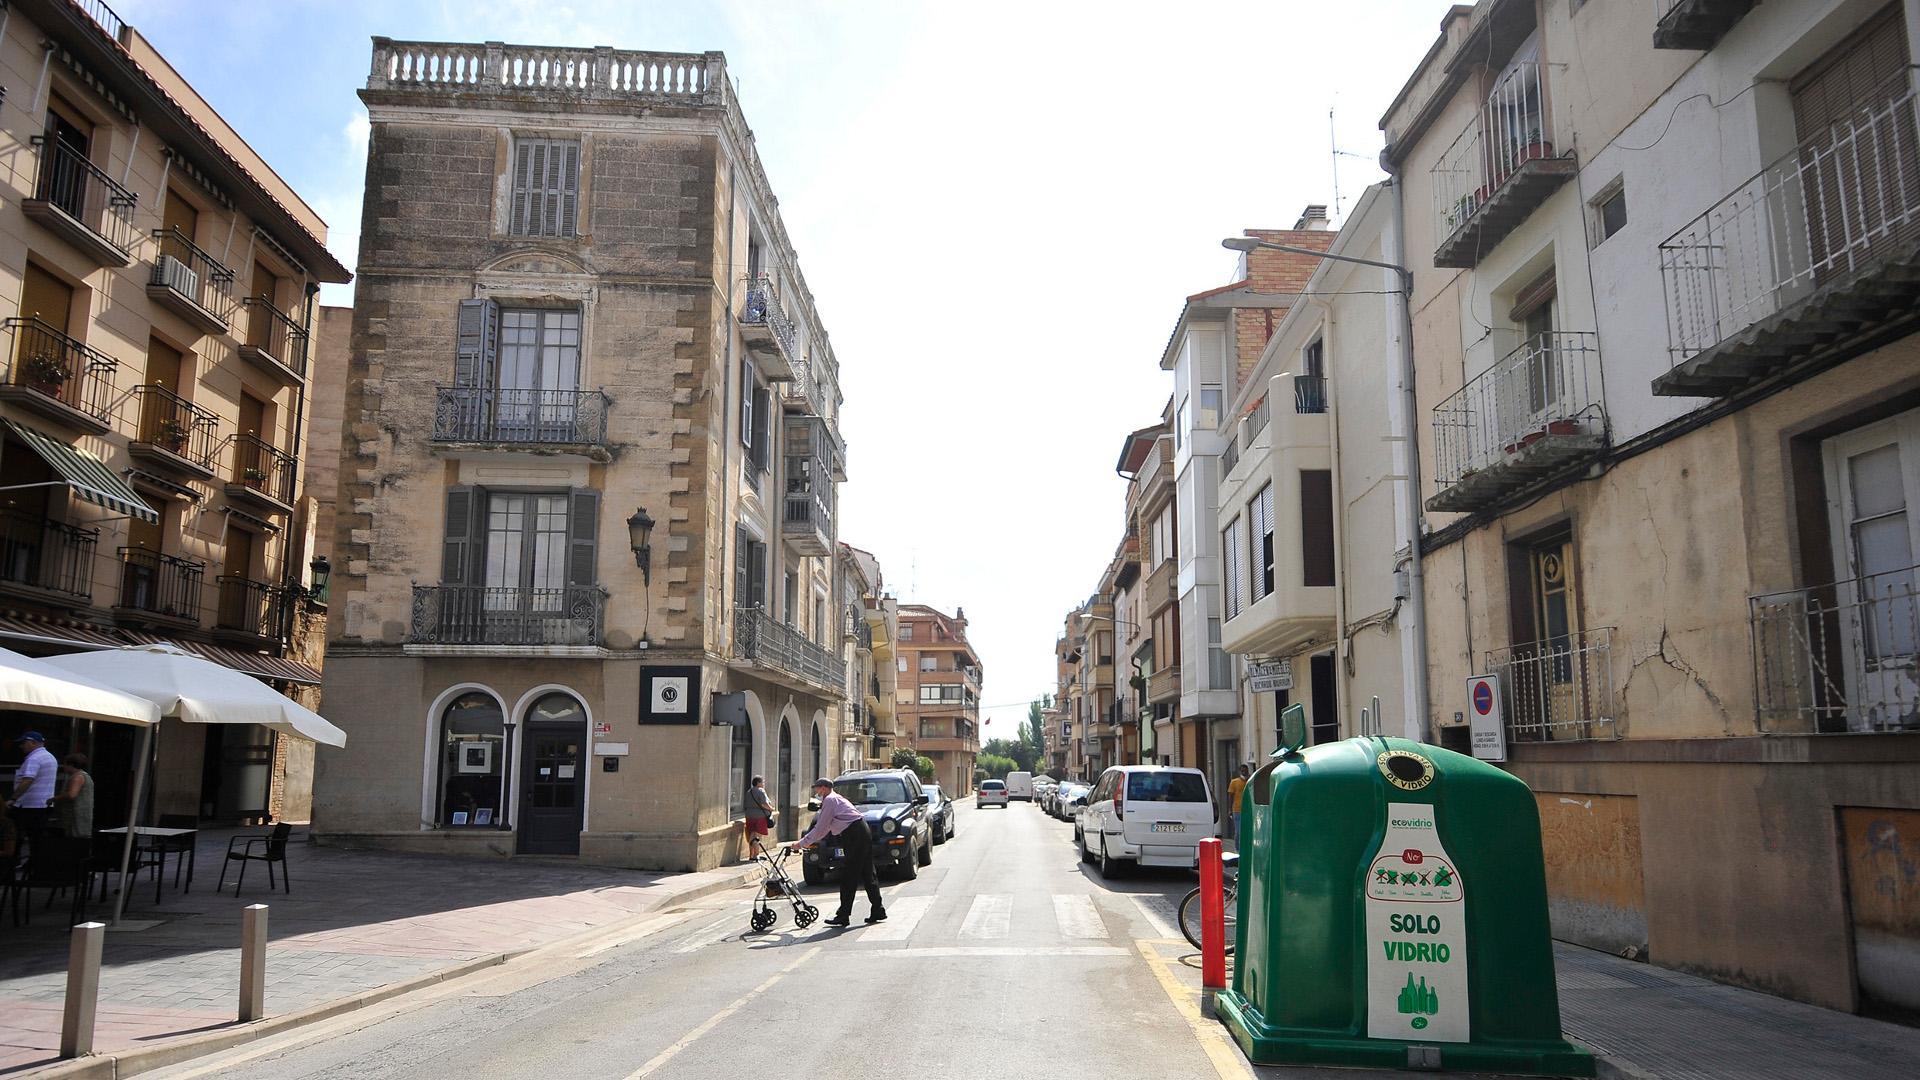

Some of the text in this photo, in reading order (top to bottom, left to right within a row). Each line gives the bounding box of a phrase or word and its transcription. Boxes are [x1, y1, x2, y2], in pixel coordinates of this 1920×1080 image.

[1387, 773, 1431, 789] DE VIDRIO
[1391, 818, 1432, 827] ecovidrio
[1407, 852, 1419, 861] No
[1390, 913, 1440, 934] SOLO
[1383, 941, 1450, 963] VIDRIO
